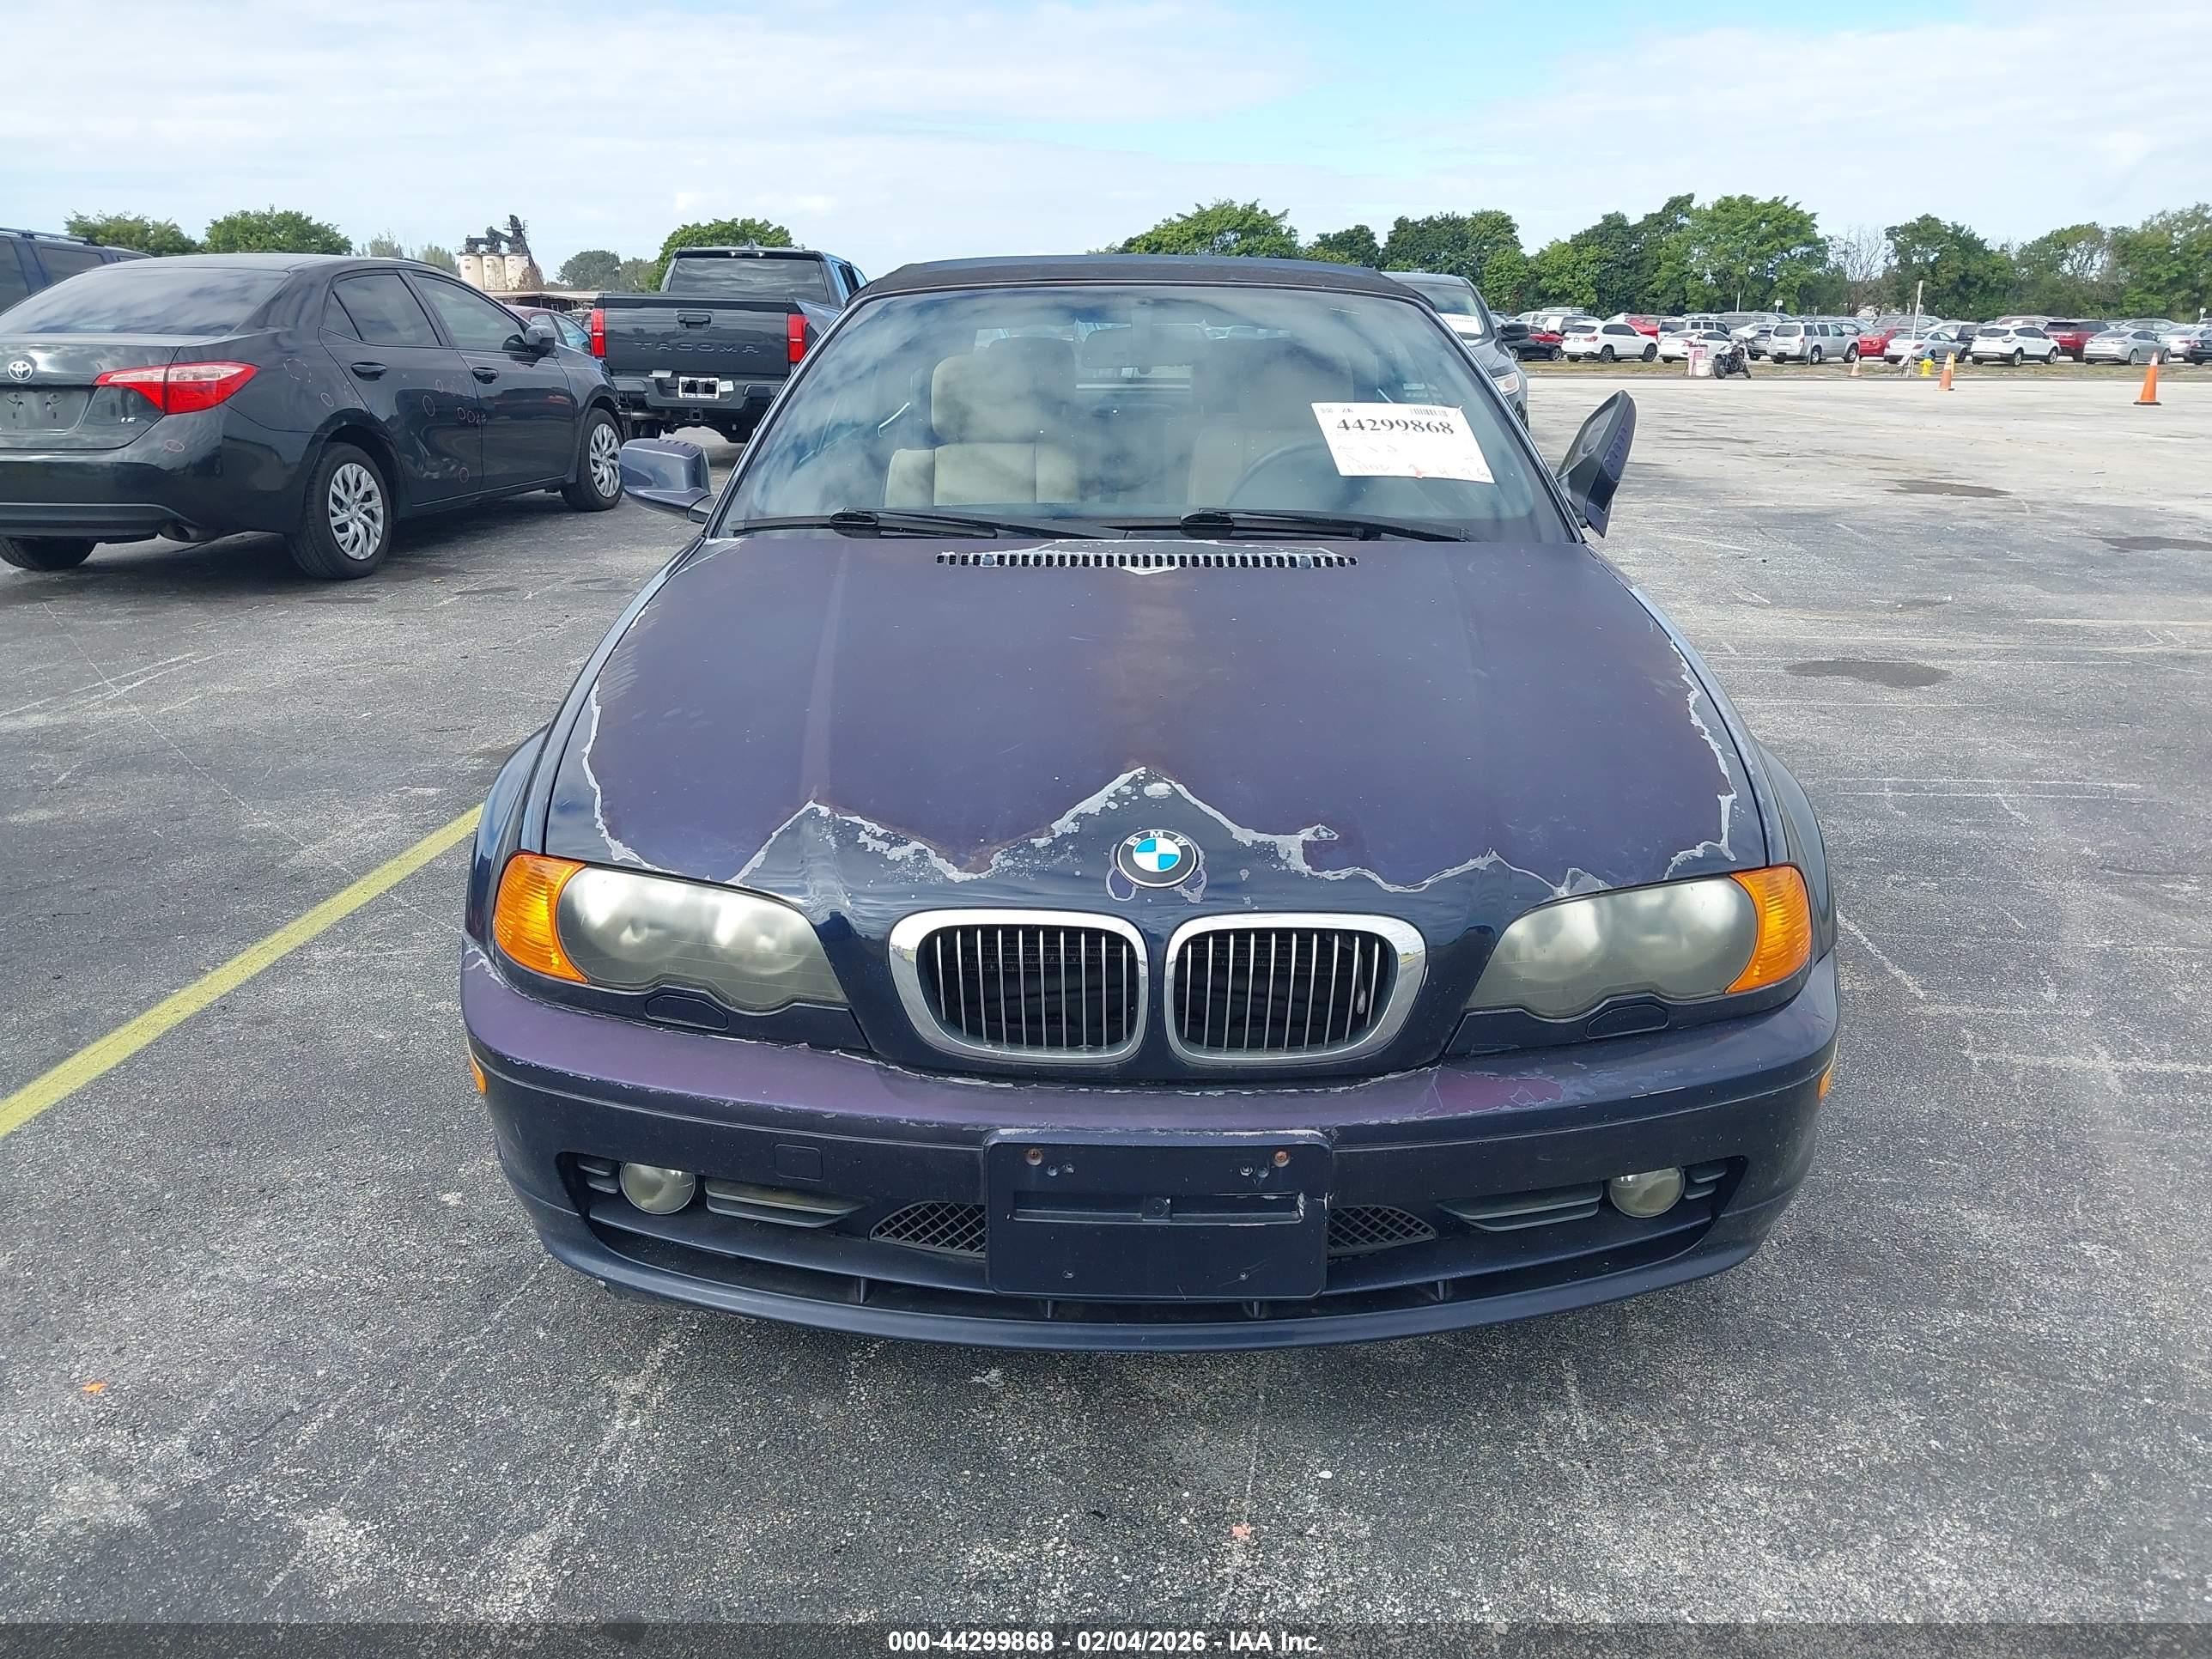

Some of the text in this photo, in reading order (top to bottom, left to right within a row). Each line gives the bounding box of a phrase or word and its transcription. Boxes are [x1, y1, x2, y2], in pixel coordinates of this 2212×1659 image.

[634, 342, 760, 354] TACOMA
[1337, 418, 1455, 434] 44299868
[1126, 830, 1189, 847] BMW
